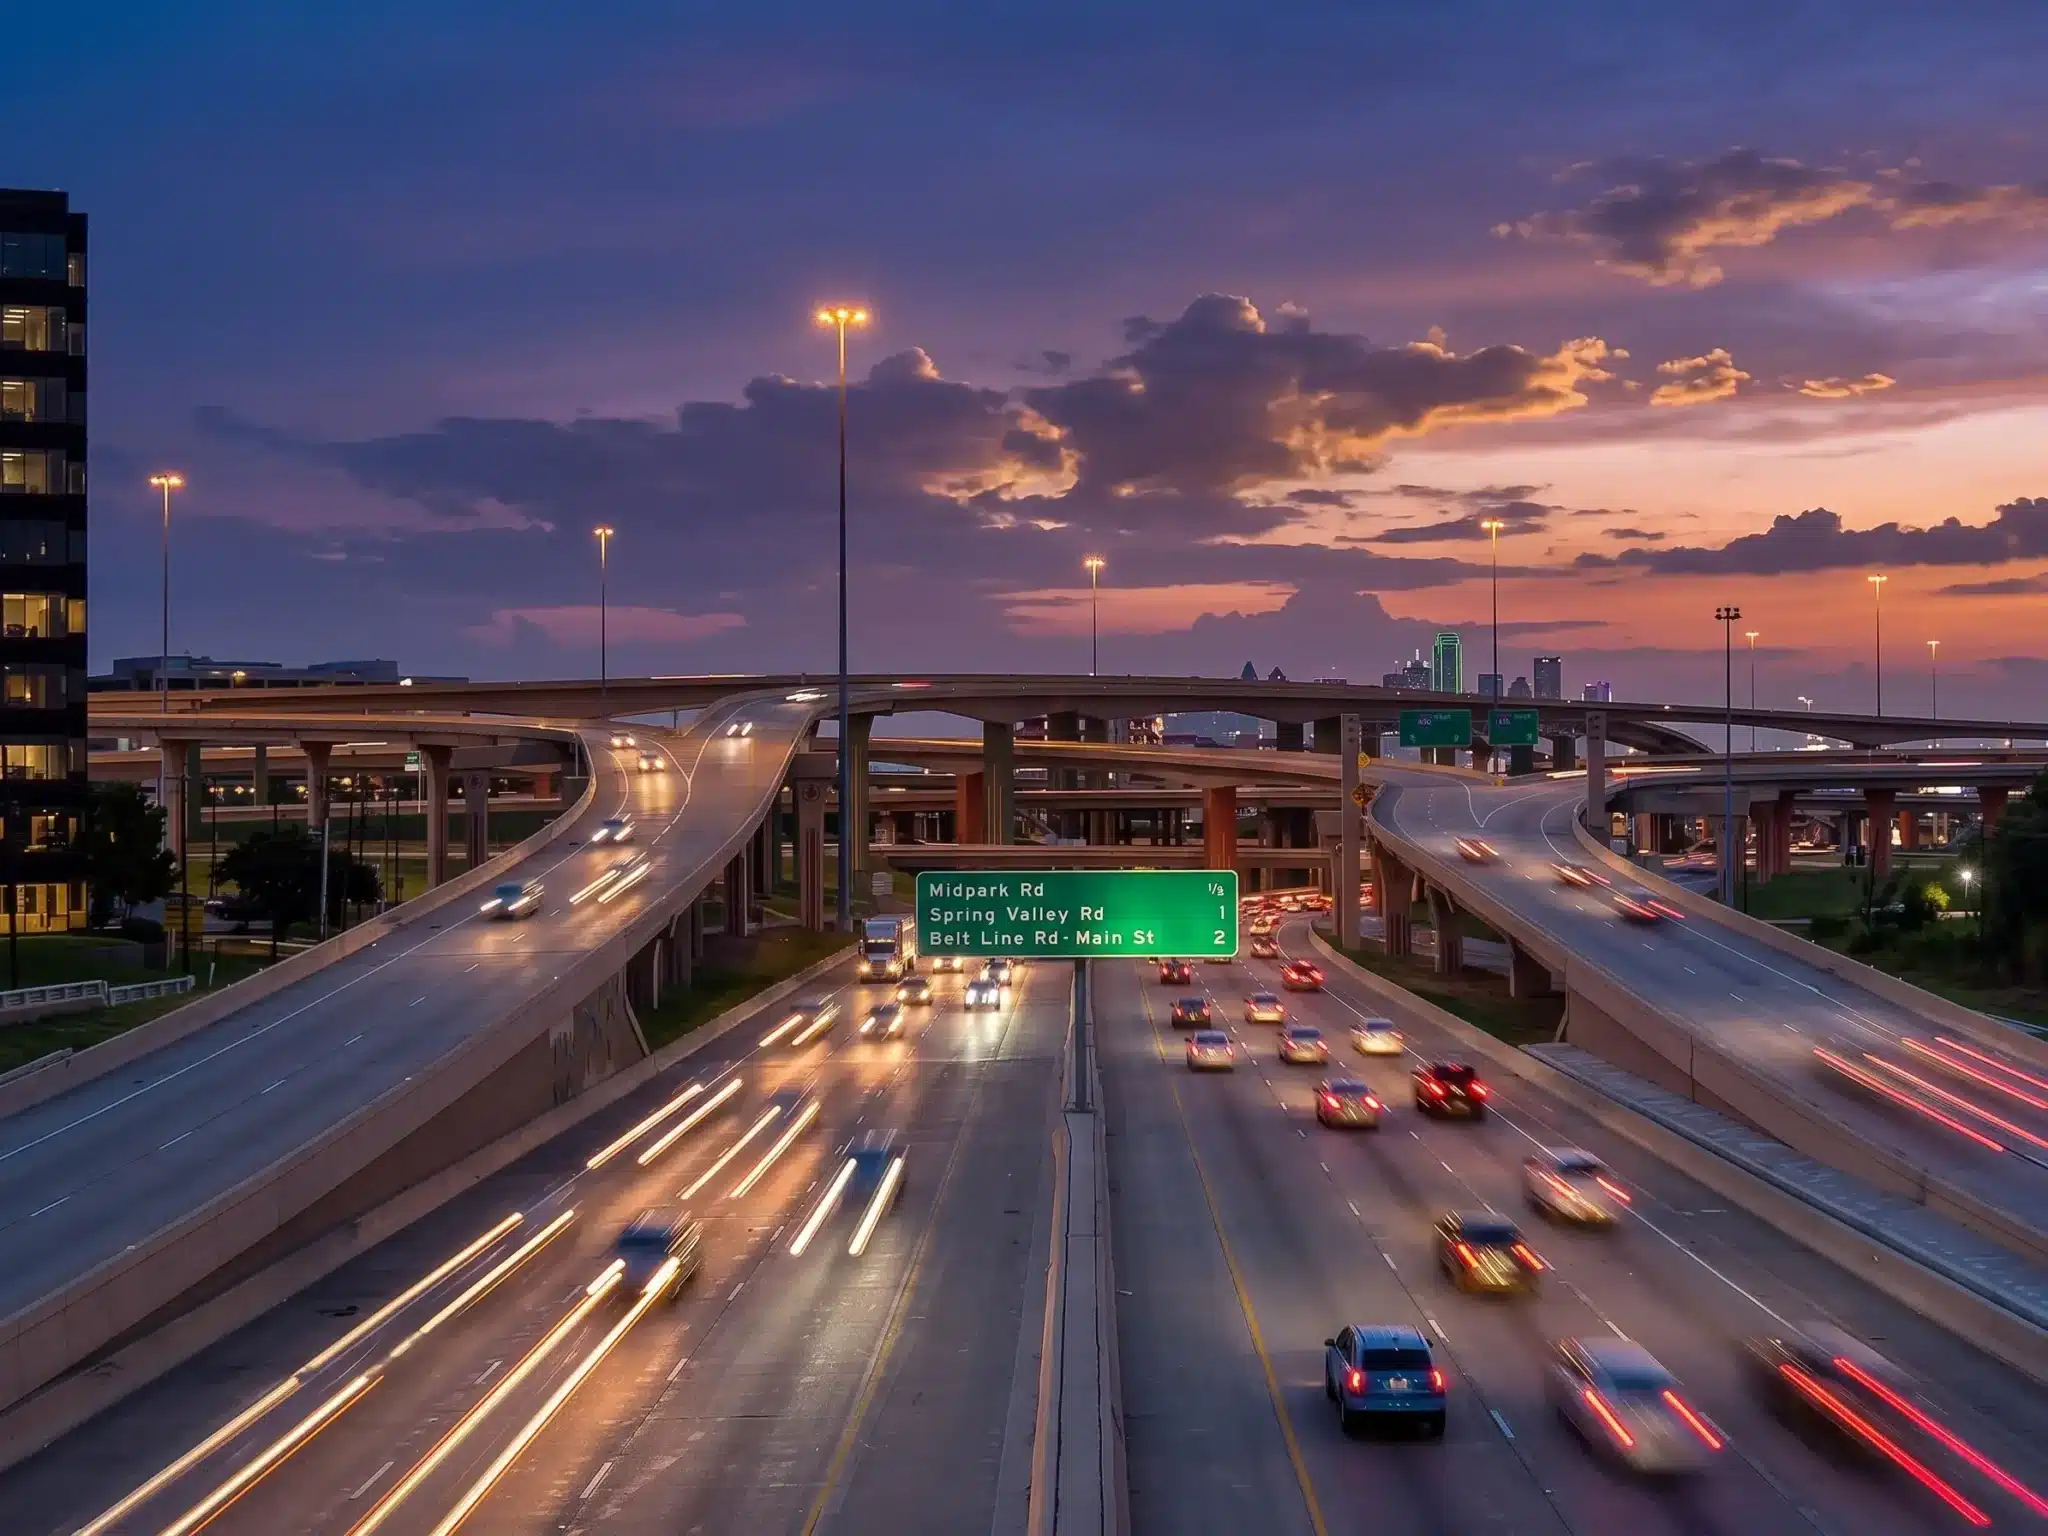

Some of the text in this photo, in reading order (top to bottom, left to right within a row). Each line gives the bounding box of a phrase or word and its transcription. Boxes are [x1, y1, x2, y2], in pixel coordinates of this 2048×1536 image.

[930, 882, 1044, 901] Midpark Rd
[930, 906, 1104, 925] Spring Valley Rd
[1219, 905, 1225, 920] 1
[930, 931, 970, 946] Belt
[981, 931, 1024, 945] Line
[1133, 929, 1154, 945] St
[1213, 929, 1226, 945] 2
